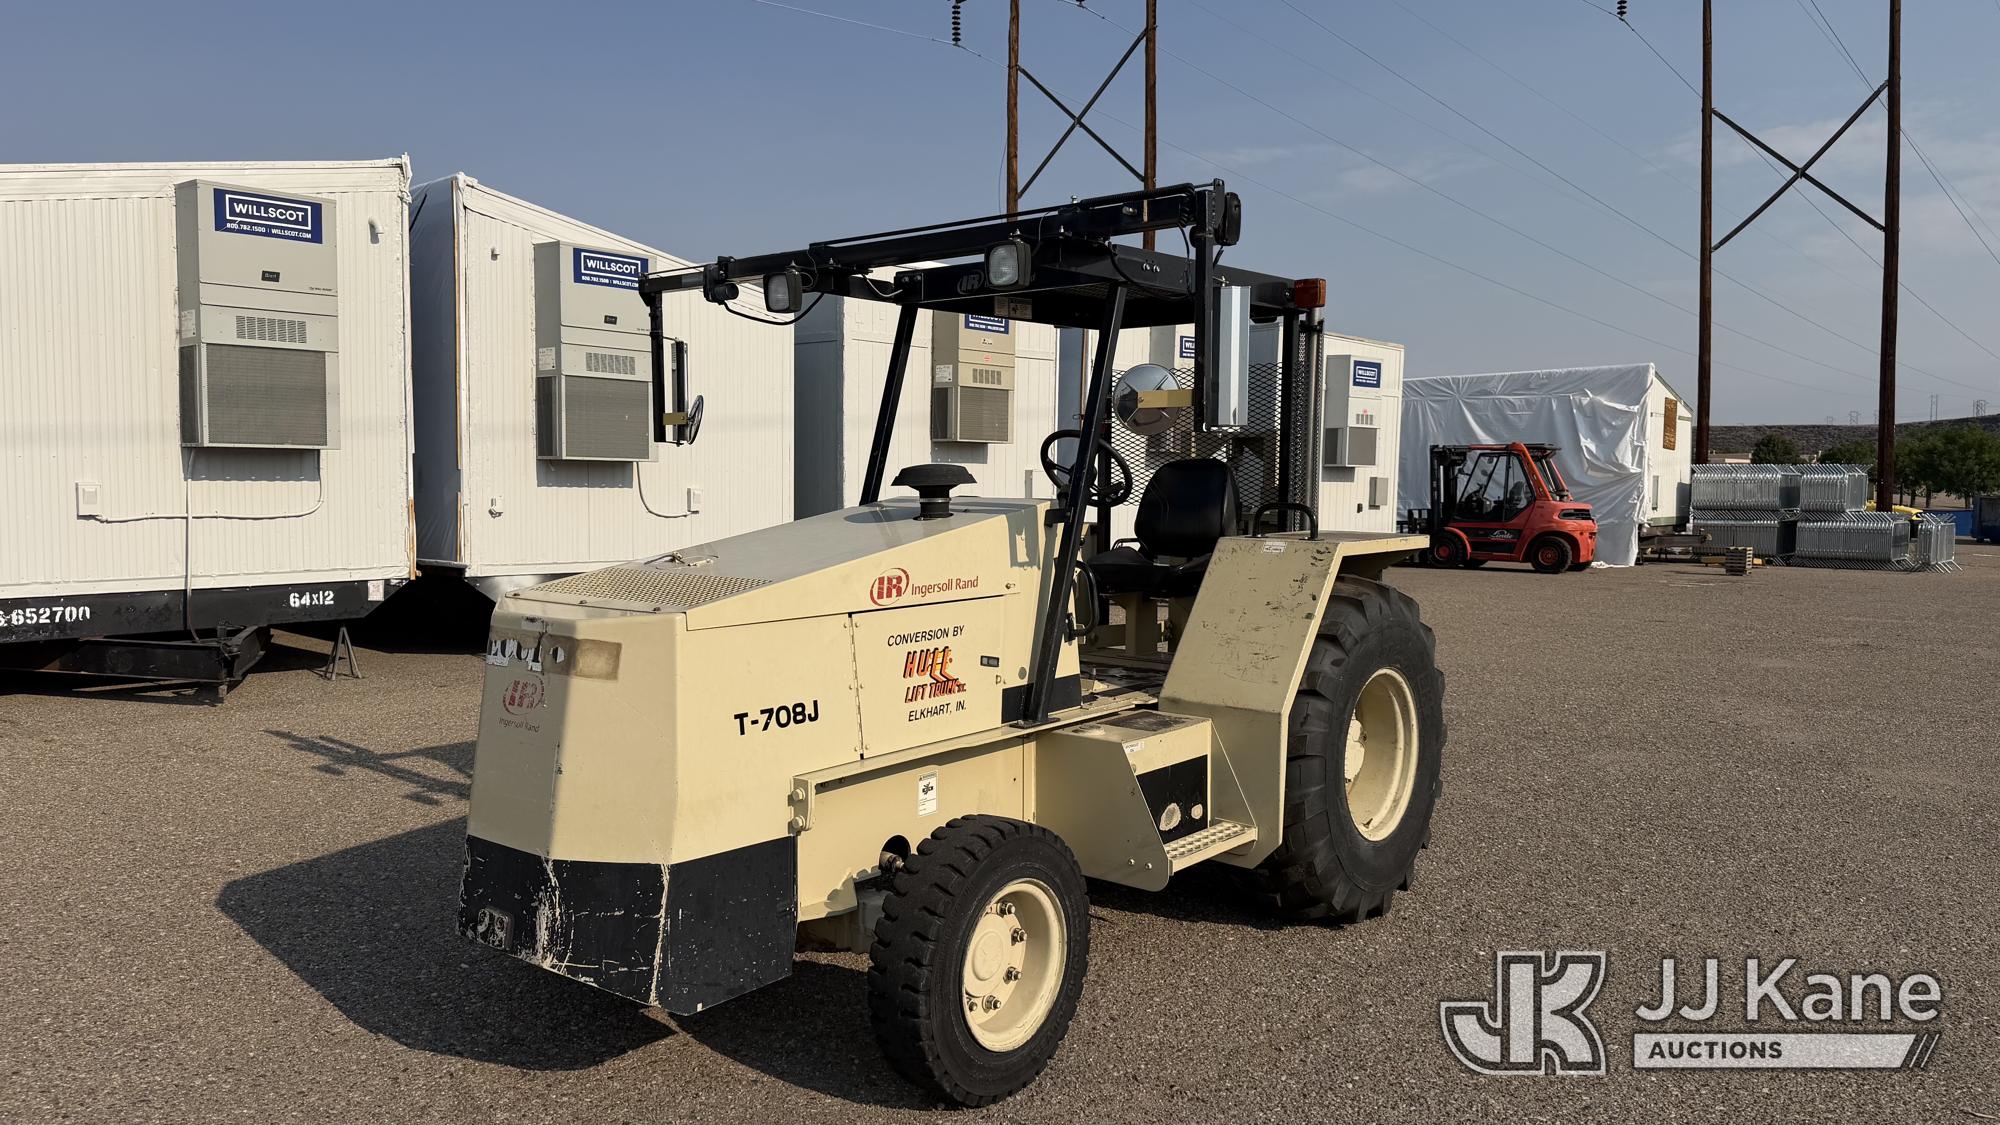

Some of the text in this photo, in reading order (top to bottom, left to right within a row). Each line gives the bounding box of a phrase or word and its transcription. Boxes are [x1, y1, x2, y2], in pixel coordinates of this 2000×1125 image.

[233, 202, 305, 222] WILLSCOT
[271, 228, 312, 239] WILLSCOT.COM
[586, 259, 637, 274] WILLSCOT
[911, 578, 953, 598] Ingersoll
[955, 575, 979, 590] Rand
[887, 625, 965, 647] CONVERSION BY
[904, 683, 928, 704] LIFT
[733, 699, 820, 736] T-708J
[908, 700, 967, 722] ELKHART, IN.
